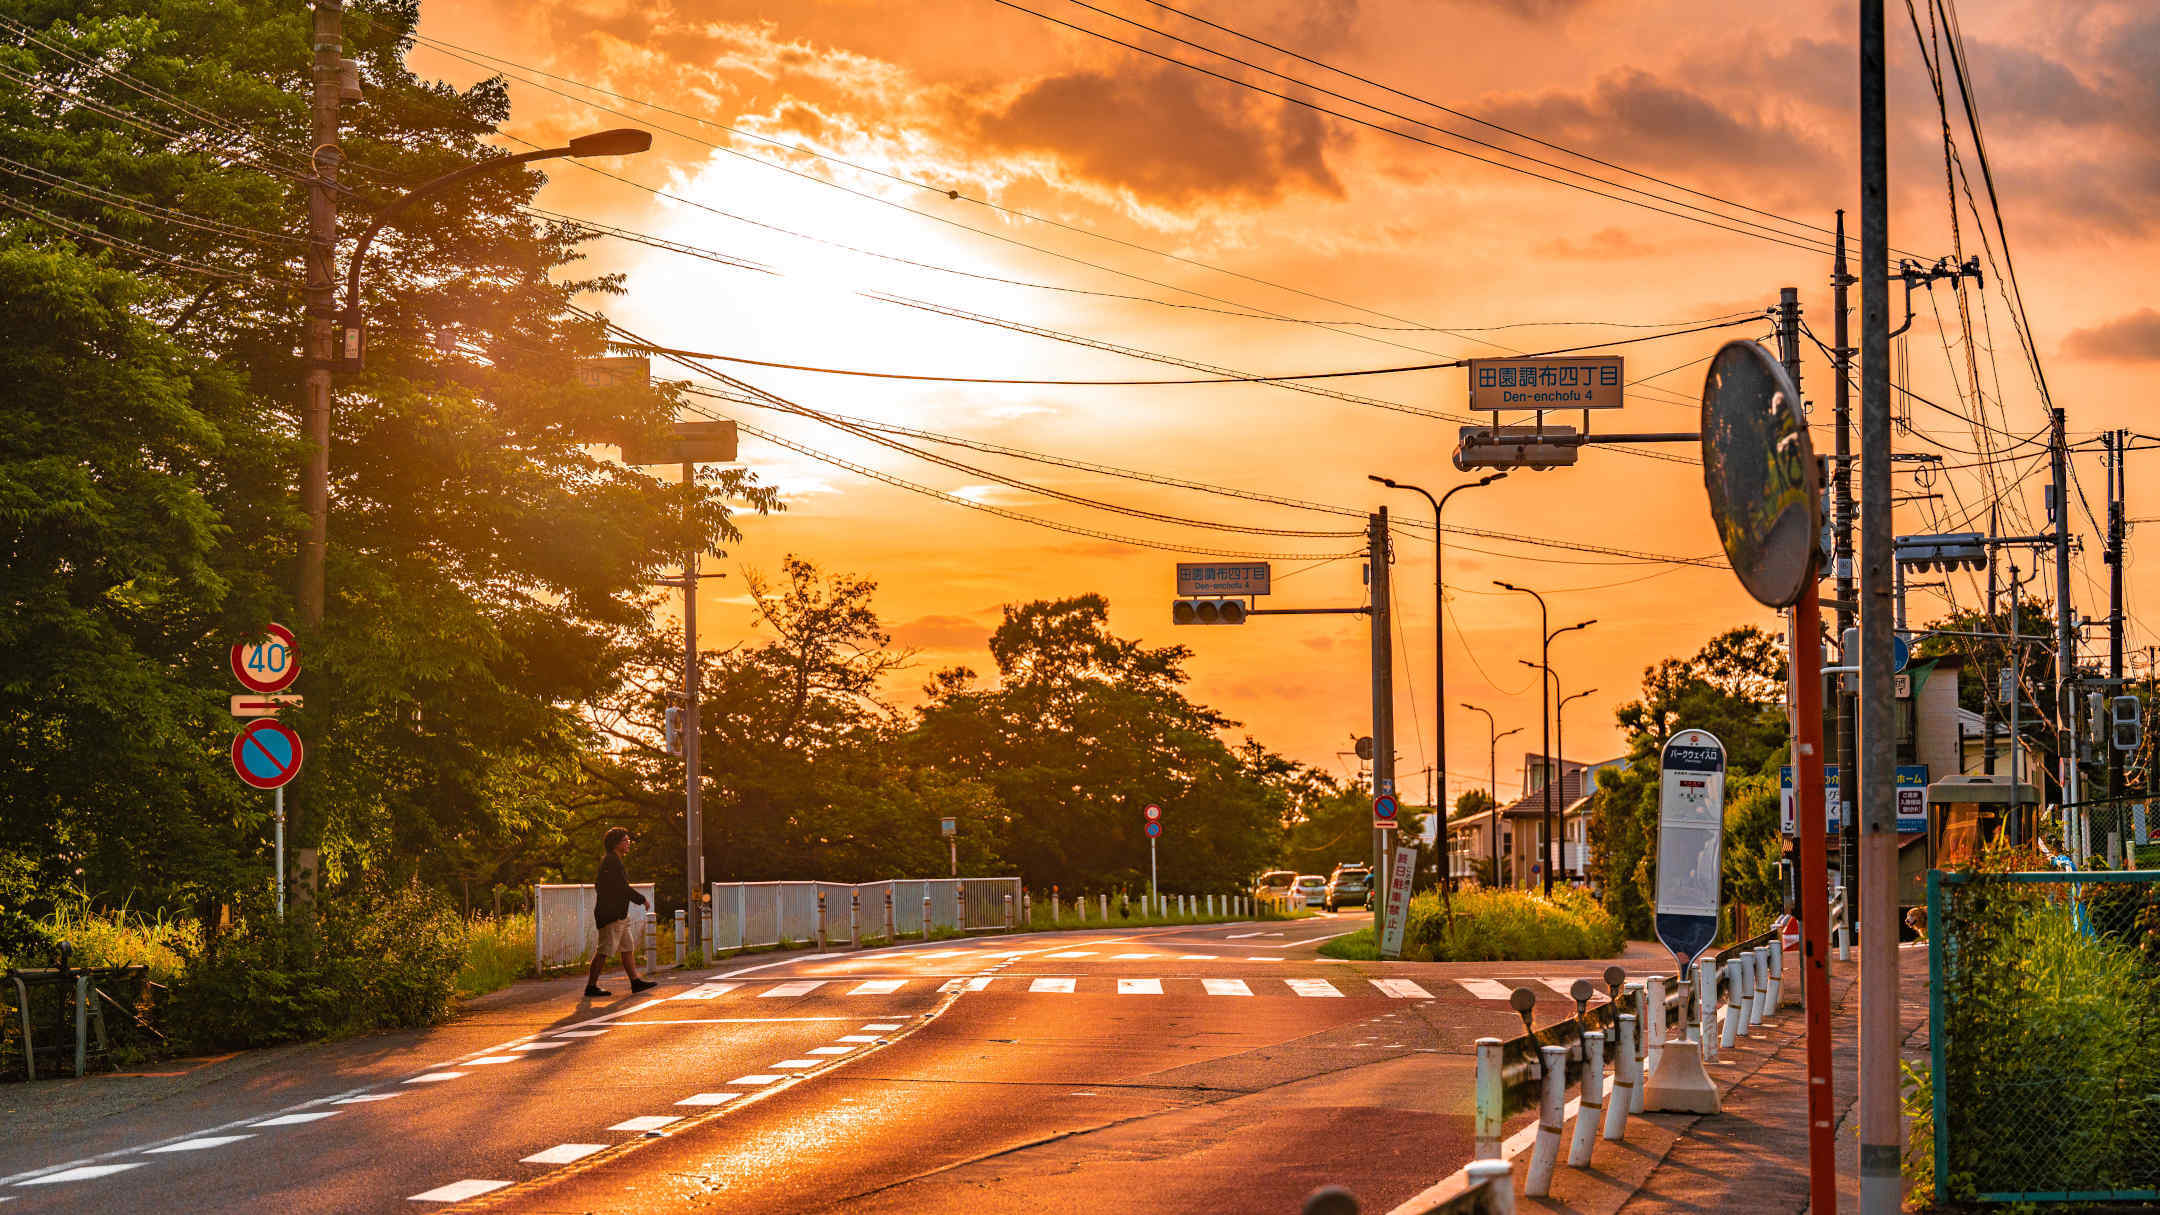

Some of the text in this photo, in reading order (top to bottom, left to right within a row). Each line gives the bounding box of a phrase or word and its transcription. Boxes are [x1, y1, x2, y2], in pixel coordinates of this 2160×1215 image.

[1479, 365, 1617, 388] 田園調布四丁目
[1503, 389, 1593, 402] Den-enchofu 4
[247, 643, 286, 673] 40
